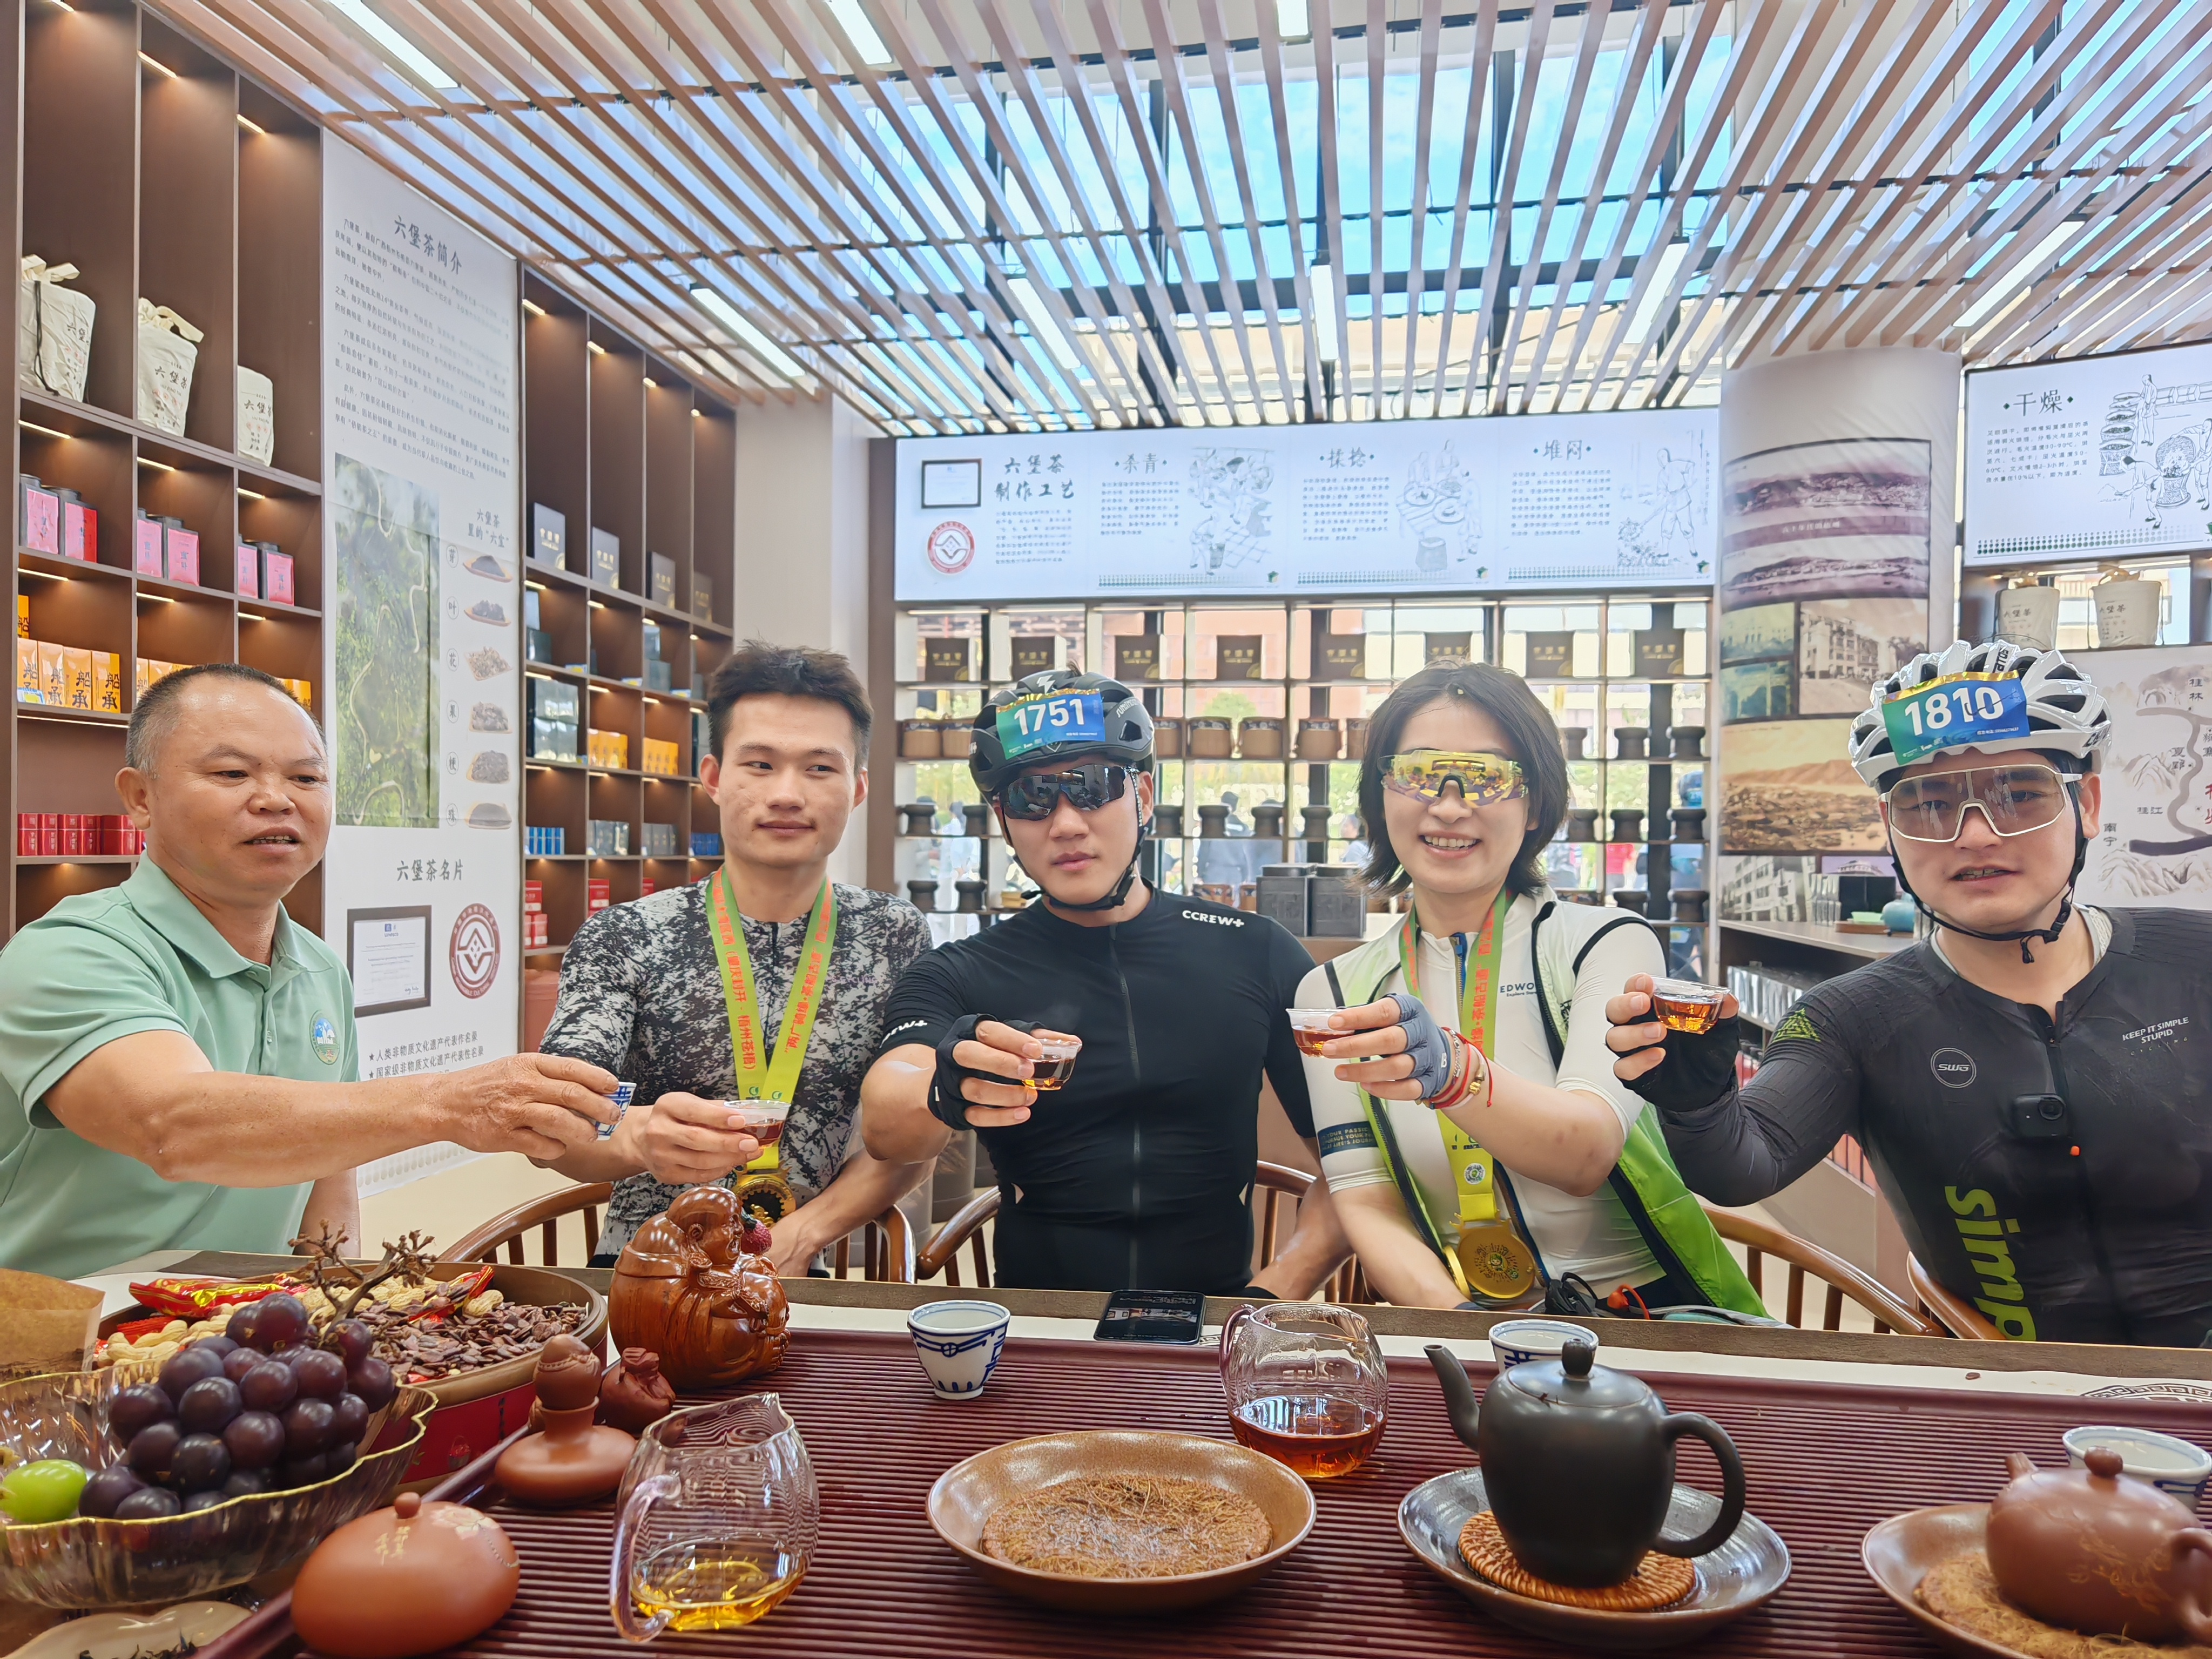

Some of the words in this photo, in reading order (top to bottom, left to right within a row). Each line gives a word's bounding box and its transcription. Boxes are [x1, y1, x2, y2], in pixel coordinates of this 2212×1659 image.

[394, 215, 462, 275] 六堡茶简介
[154, 365, 187, 389] 六堡茶
[2012, 389, 2063, 416] 干燥
[1003, 454, 1064, 475] 六堡茶
[1123, 453, 1159, 474] 杀青
[994, 478, 1075, 502] 制作工艺
[476, 507, 500, 528] 六堡茶
[448, 600, 457, 617] 叶
[449, 652, 457, 669] 花
[72, 669, 91, 708] 船承
[102, 672, 120, 709] 船承
[2189, 678, 2203, 702] 桂林
[449, 704, 457, 720] 果
[1014, 698, 1084, 736] 1751
[1904, 686, 2004, 737] 1810
[2103, 822, 2117, 846] 南宁
[396, 858, 464, 882] 六堡茶名片
[1182, 910, 1245, 927] CCREW+
[2122, 1028, 2146, 1041] KEEP
[2148, 1024, 2157, 1034] IT
[2157, 1017, 2189, 1030] SIMPLE
[2141, 1029, 2173, 1044] STUPID
[376, 1030, 478, 1062] 人类非物质文化遗产代表作名录
[376, 1045, 484, 1079] 国家级非物质文化遗产代表性名录
[1937, 1063, 1971, 1071] SWG
